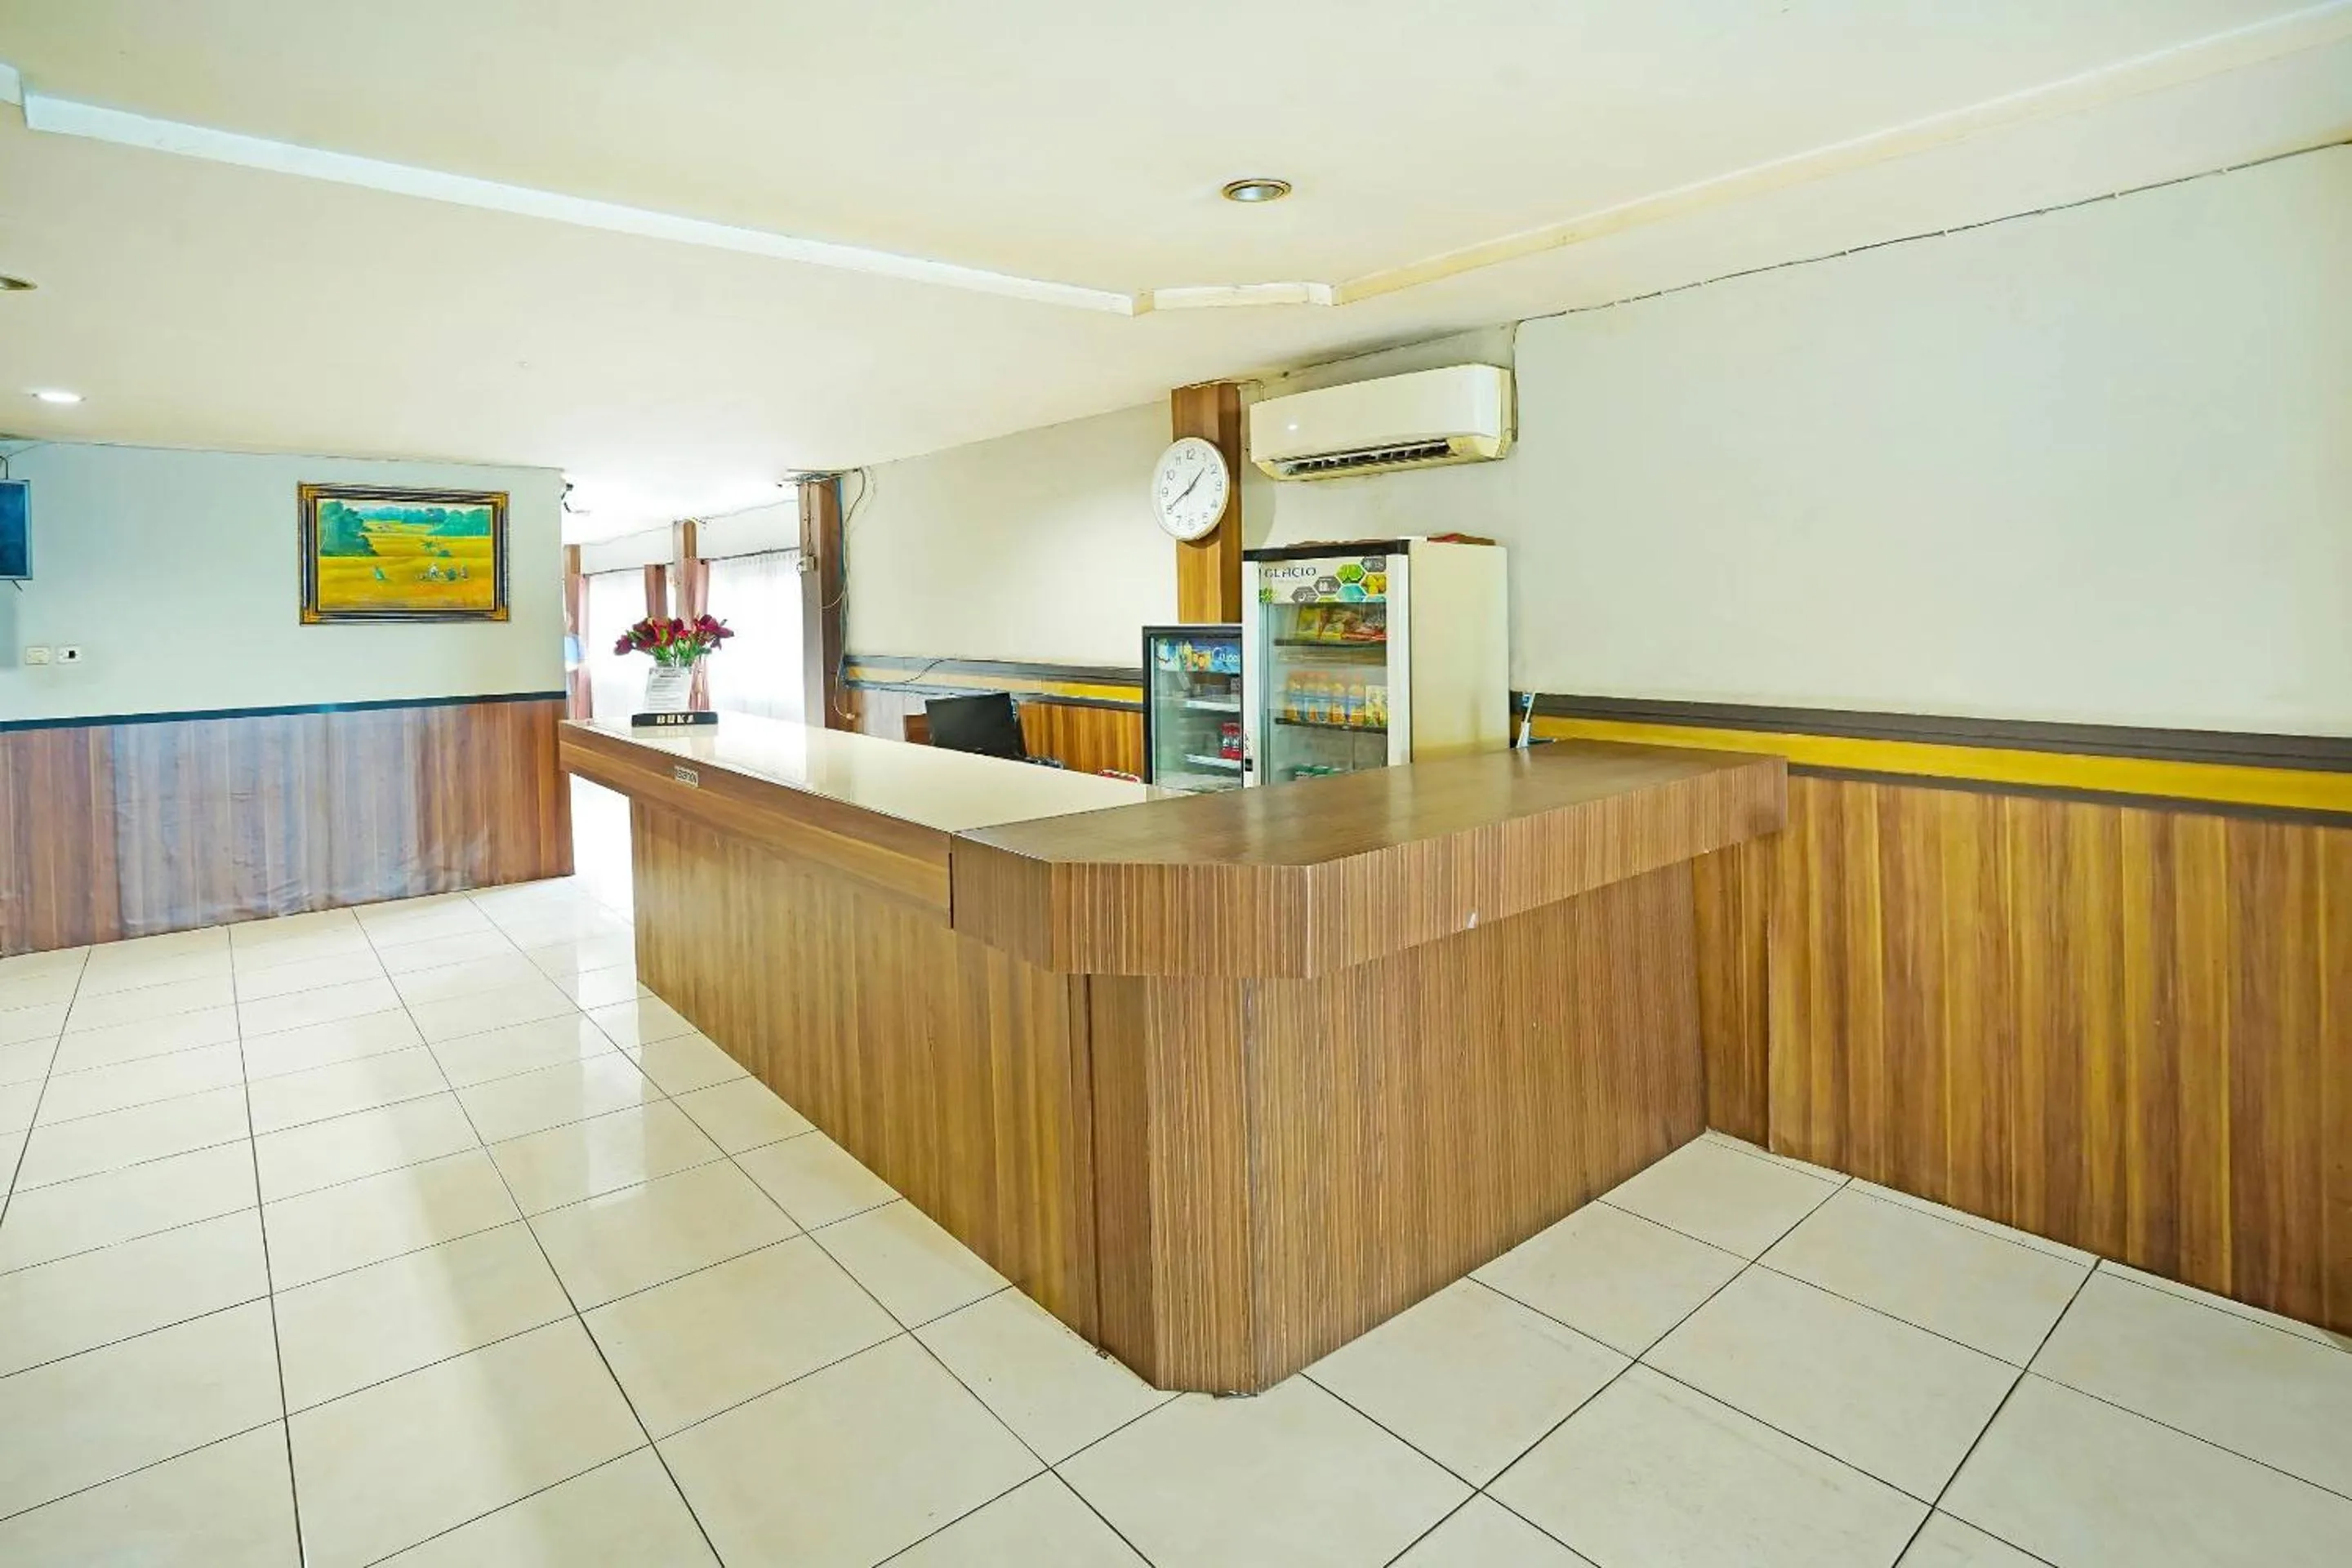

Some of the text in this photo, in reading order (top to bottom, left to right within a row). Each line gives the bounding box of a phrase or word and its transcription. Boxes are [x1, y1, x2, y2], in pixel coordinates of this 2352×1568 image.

[1186, 448, 1196, 460] 12
[1175, 456, 1182, 466] 11
[1210, 463, 1218, 474] 2
[1166, 469, 1175, 481] 10
[1214, 479, 1222, 492] 3
[1161, 487, 1169, 497] 9
[1210, 499, 1218, 508] 4
[1166, 505, 1174, 515] 8
[1175, 515, 1182, 526] 7
[1202, 512, 1209, 524] 5
[1264, 566, 1316, 578] GLACIO
[656, 714, 695, 724] BUKA
